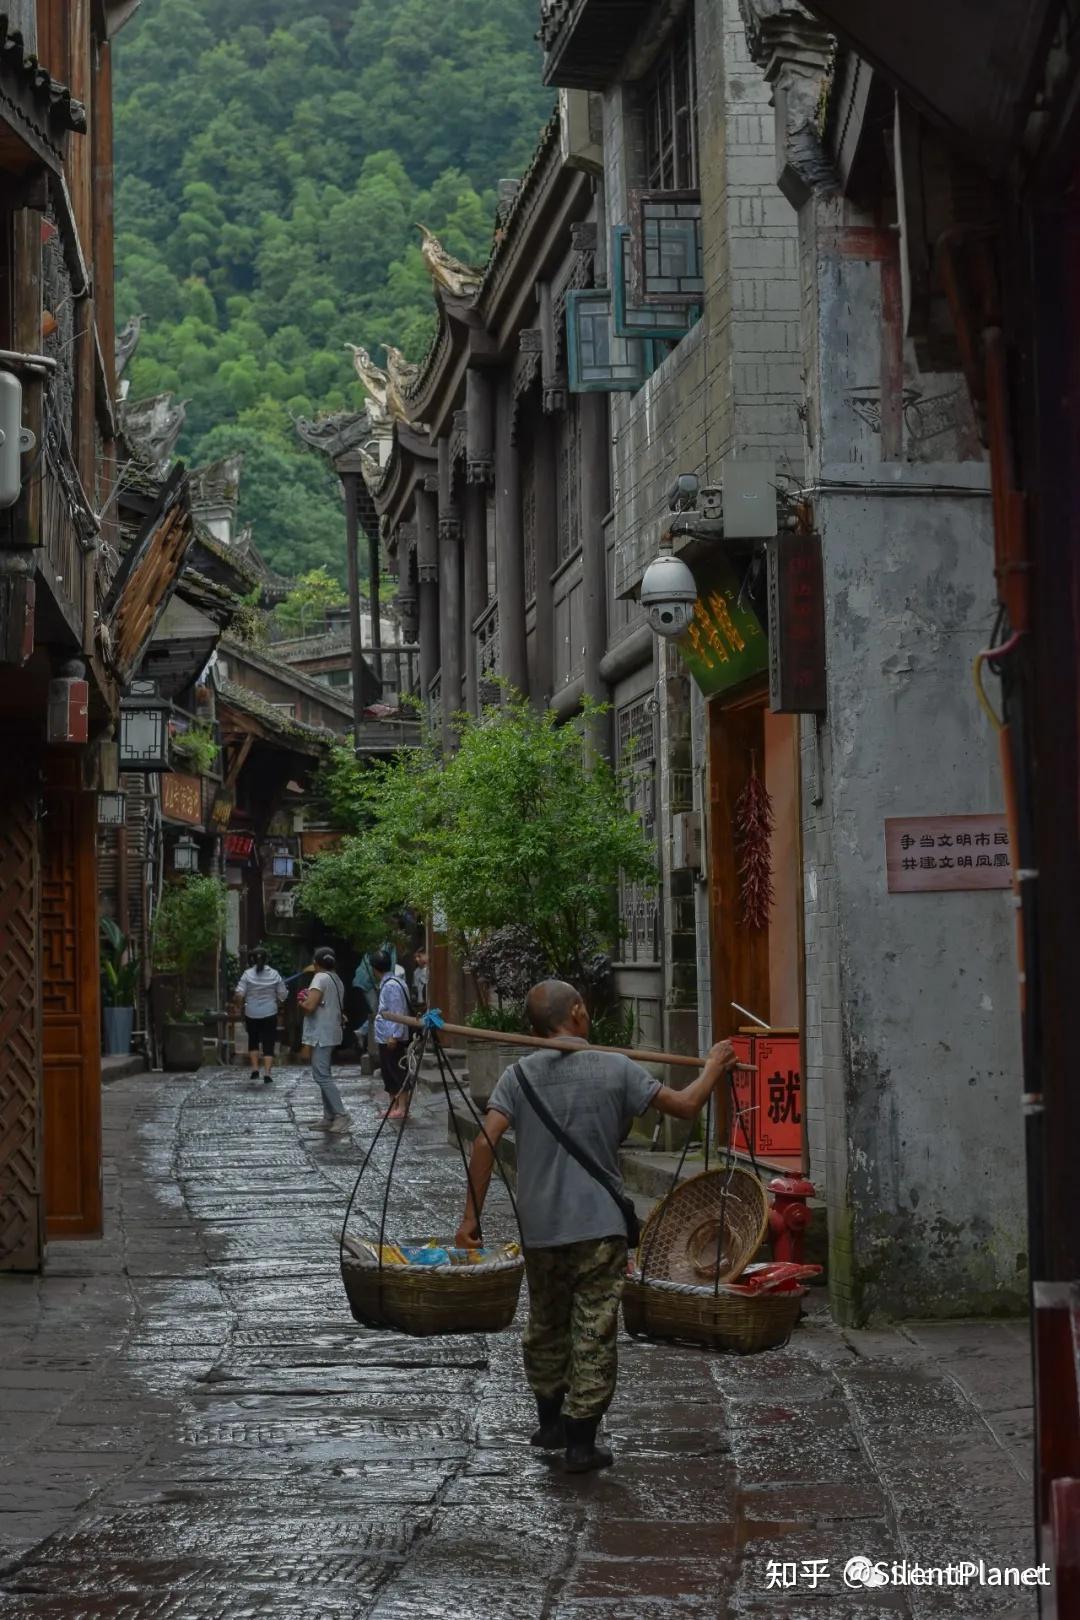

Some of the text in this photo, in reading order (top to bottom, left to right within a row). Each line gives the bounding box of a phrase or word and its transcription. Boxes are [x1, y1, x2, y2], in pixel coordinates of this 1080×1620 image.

[900, 832, 1009, 850] 争当文明市民
[901, 853, 1010, 870] 共建文明凤凰
[767, 1070, 801, 1124] 就
